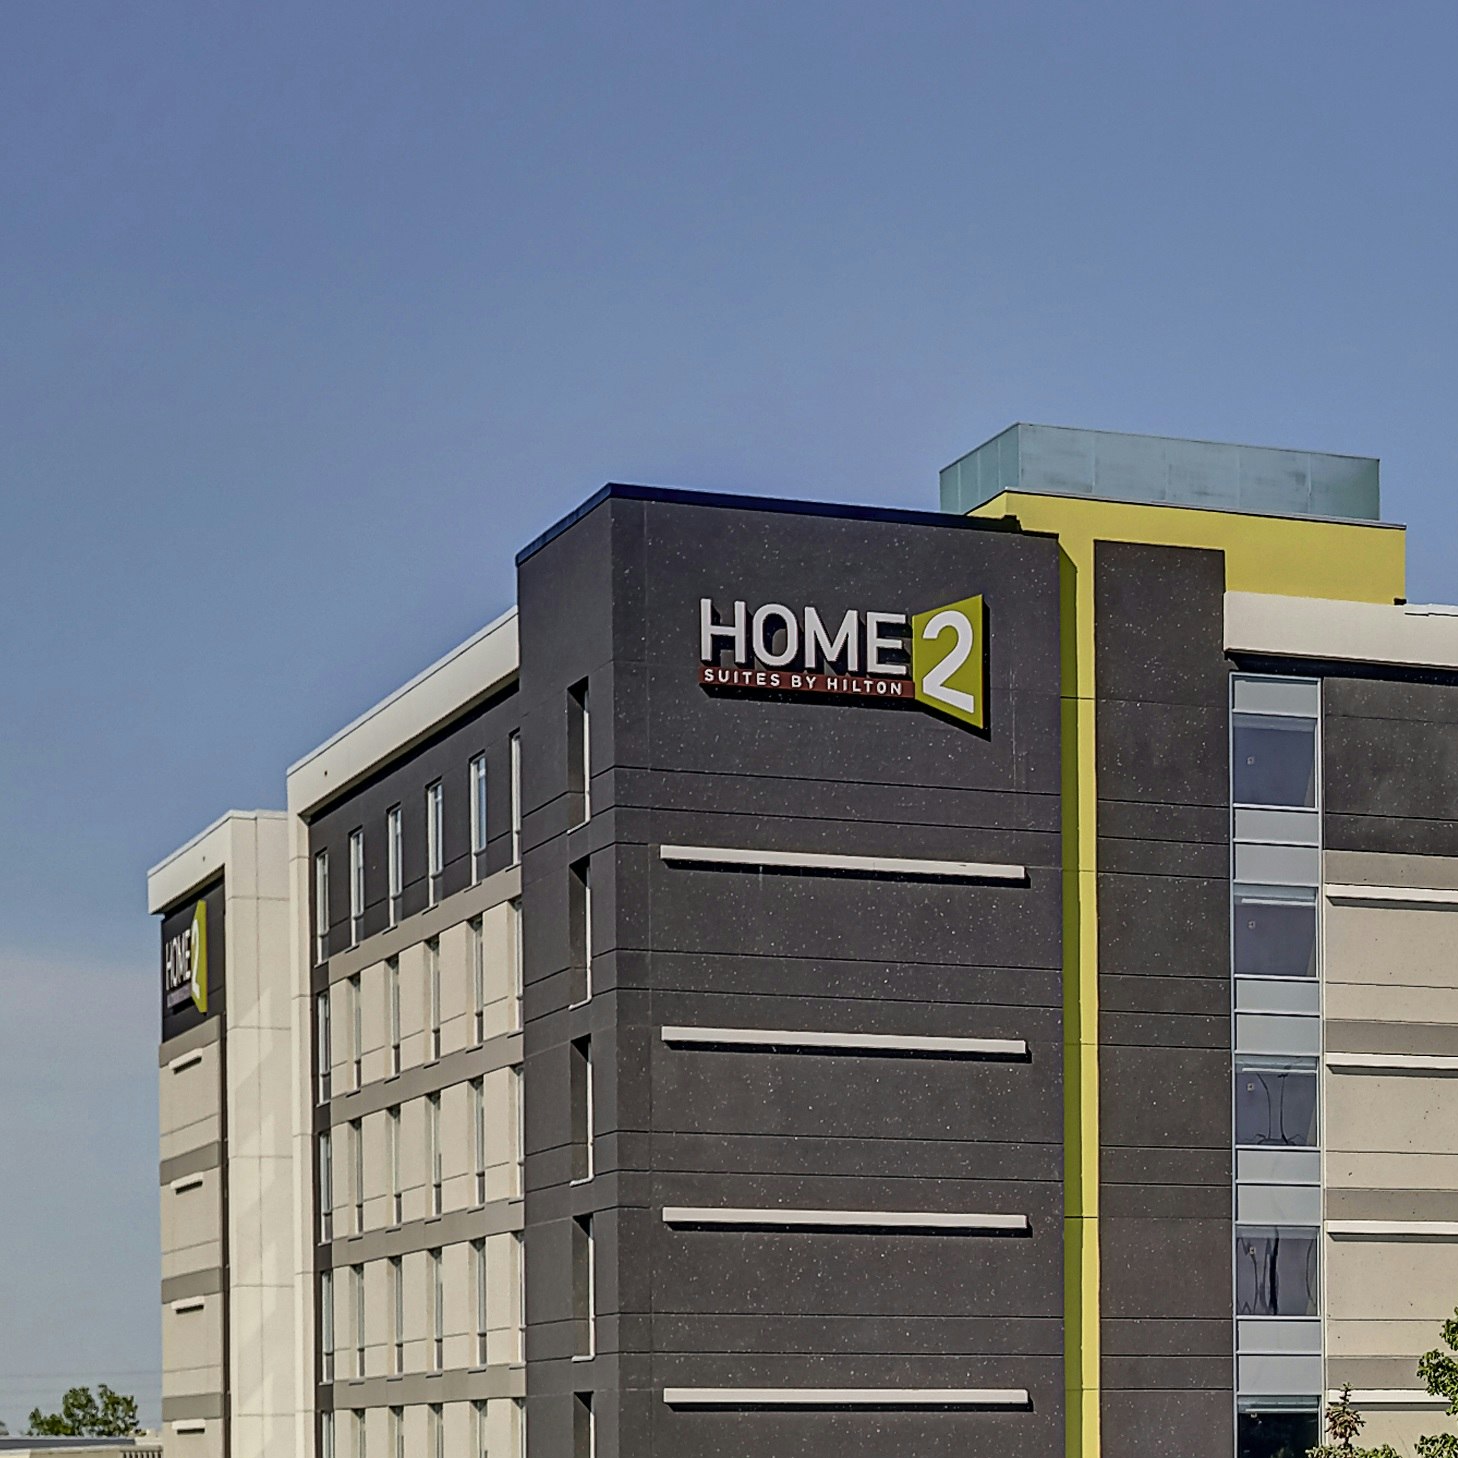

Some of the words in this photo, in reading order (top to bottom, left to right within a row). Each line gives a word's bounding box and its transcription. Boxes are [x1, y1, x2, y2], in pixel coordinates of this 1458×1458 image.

[700, 597, 907, 675] HOME
[921, 610, 975, 714] 2
[704, 668, 781, 687] SUITES
[791, 674, 816, 690] BY
[827, 677, 902, 696] HILTON
[165, 929, 191, 991] HOME
